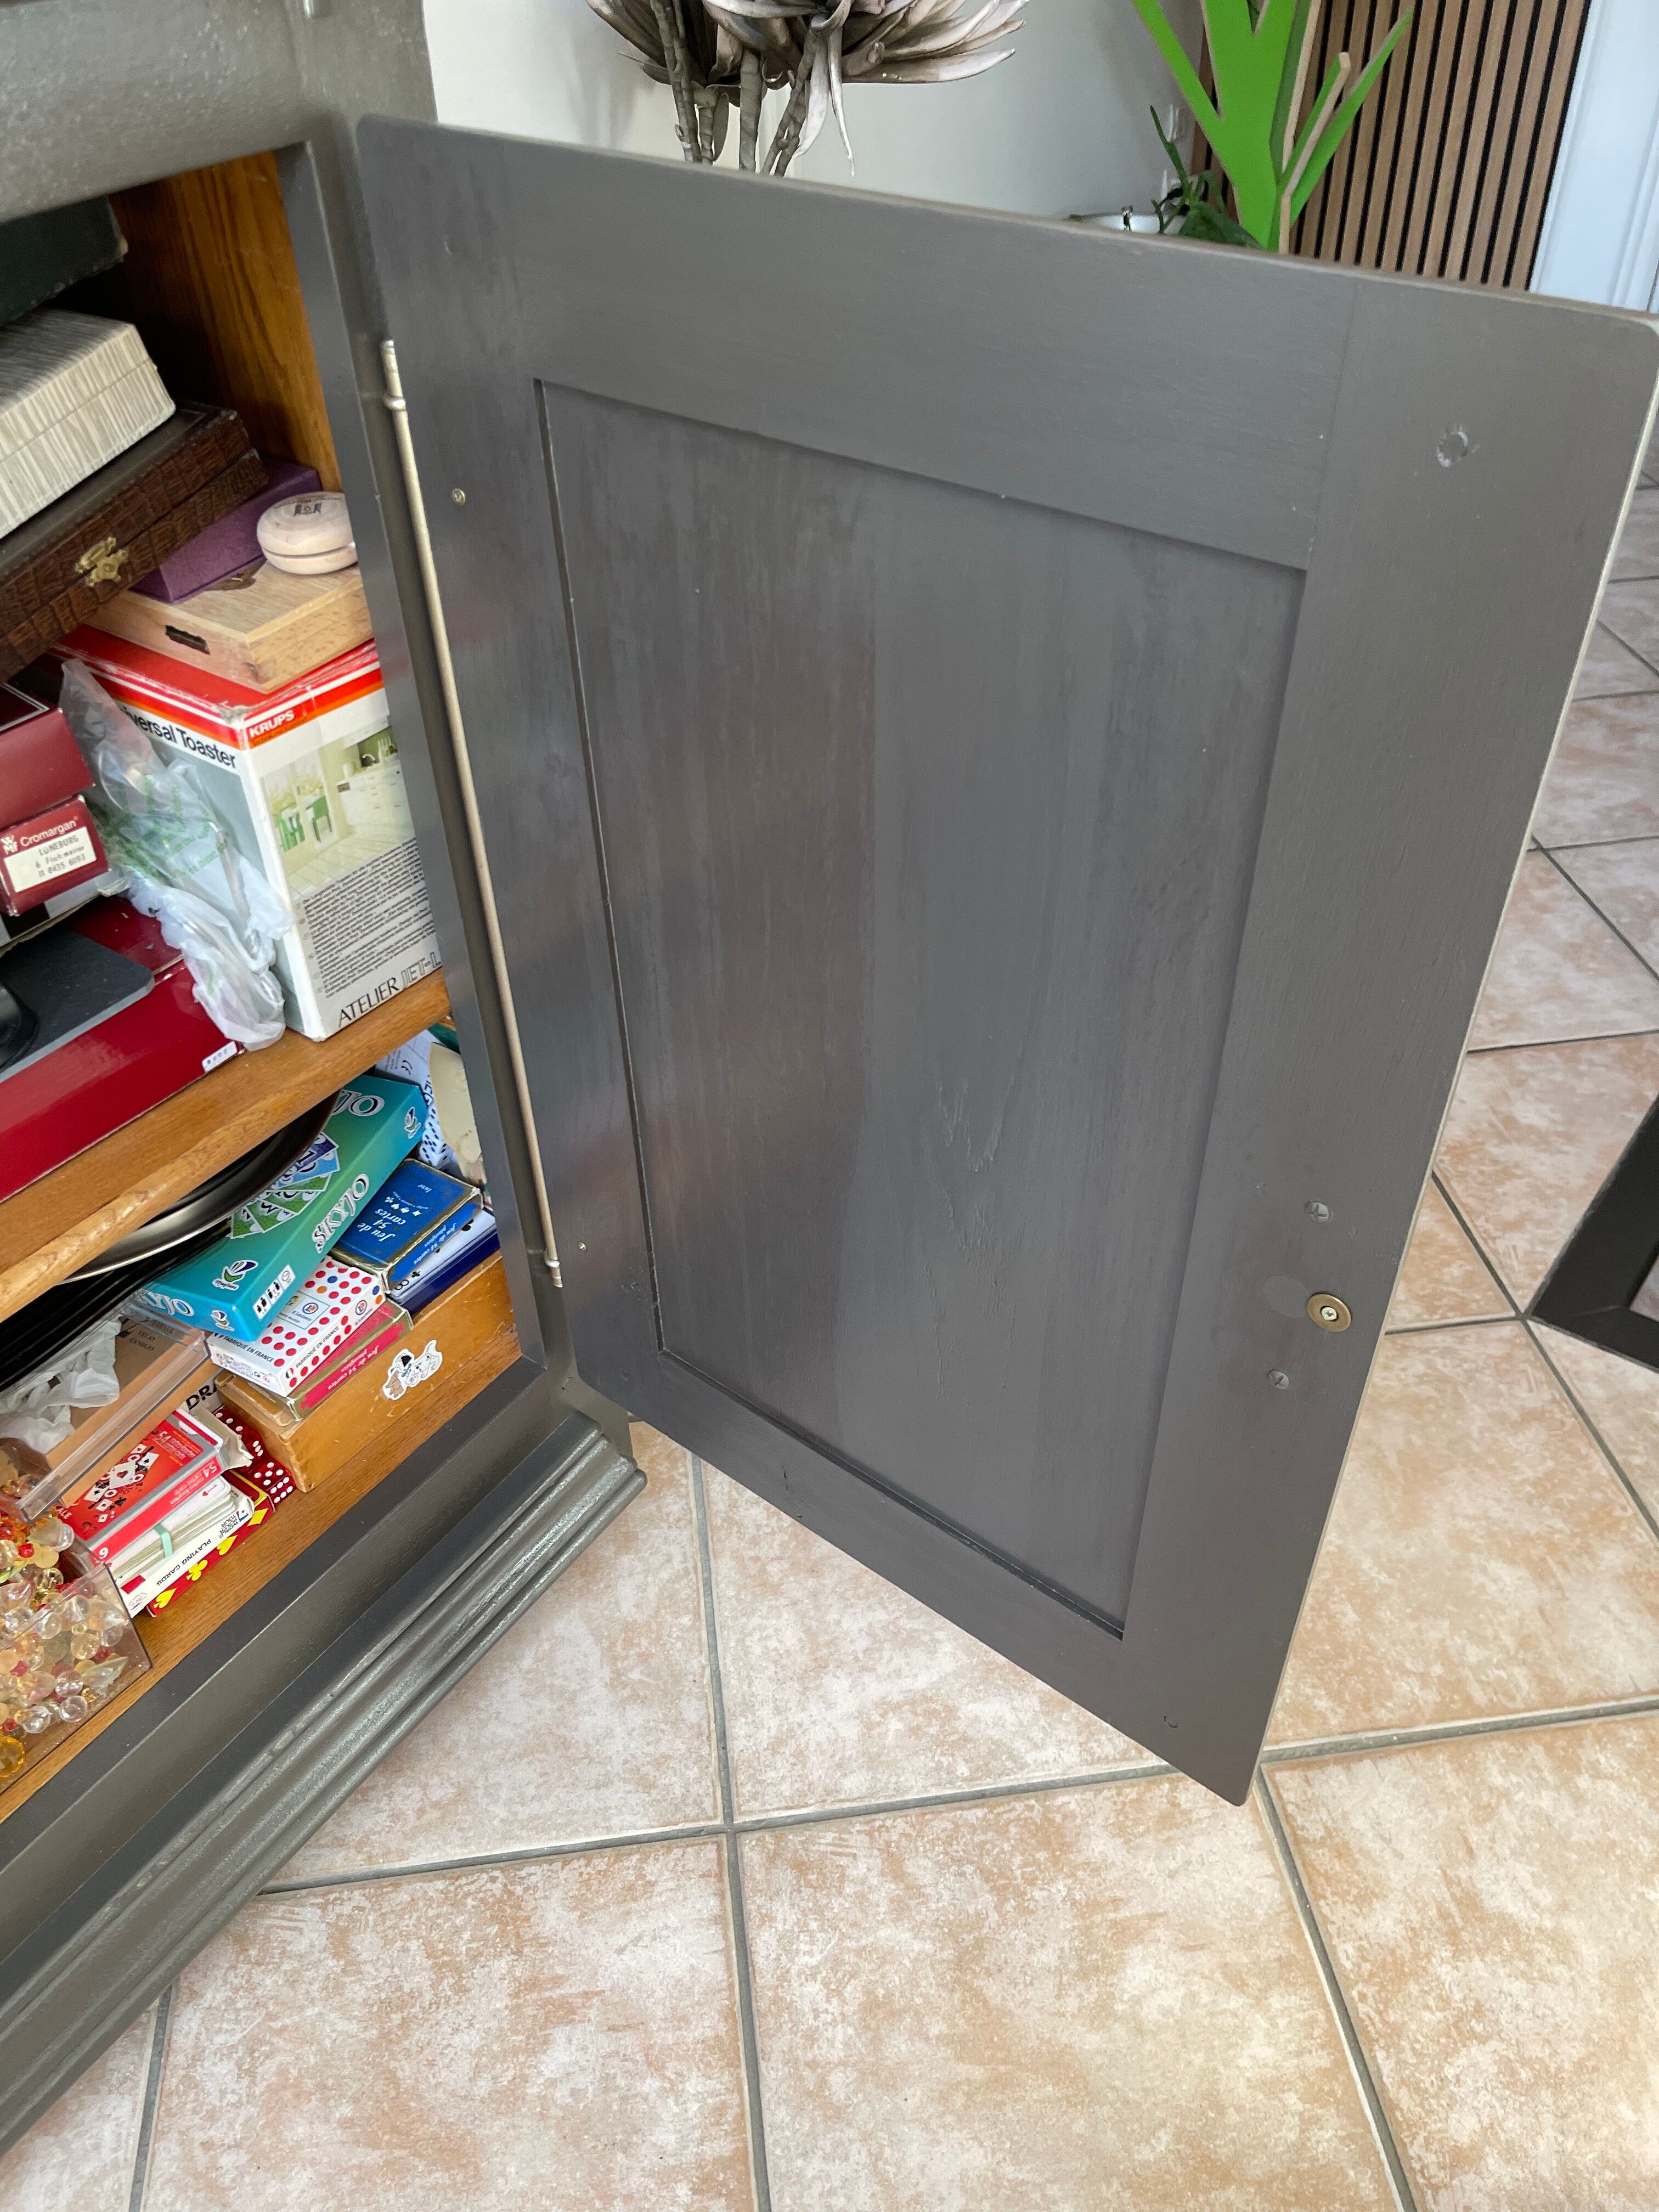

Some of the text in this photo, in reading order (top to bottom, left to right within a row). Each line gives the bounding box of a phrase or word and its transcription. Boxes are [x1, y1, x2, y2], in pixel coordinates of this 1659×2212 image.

[250, 709, 295, 738] KRUPS
[122, 707, 177, 743] iversal
[176, 727, 236, 769] Toaster
[338, 977, 400, 1028] ATELIER
[312, 1174, 369, 1254] SKYJO
[373, 1218, 392, 1229] 54
[375, 1208, 407, 1225] cartes
[357, 1222, 396, 1243] Jeu de
[131, 1288, 195, 1317] KYJO
[323, 1325, 340, 1342] FRANCE
[223, 1336, 247, 1350] FABRIQUÉ
[254, 1351, 275, 1363] FRANCE
[154, 1431, 172, 1445] 54
[203, 1460, 217, 1478] 54
[219, 1517, 237, 1533] POKER
[219, 1521, 239, 1539] WORLD
[221, 1514, 236, 1527] TOUR
[156, 1538, 212, 1586] PLAYING CARDS
